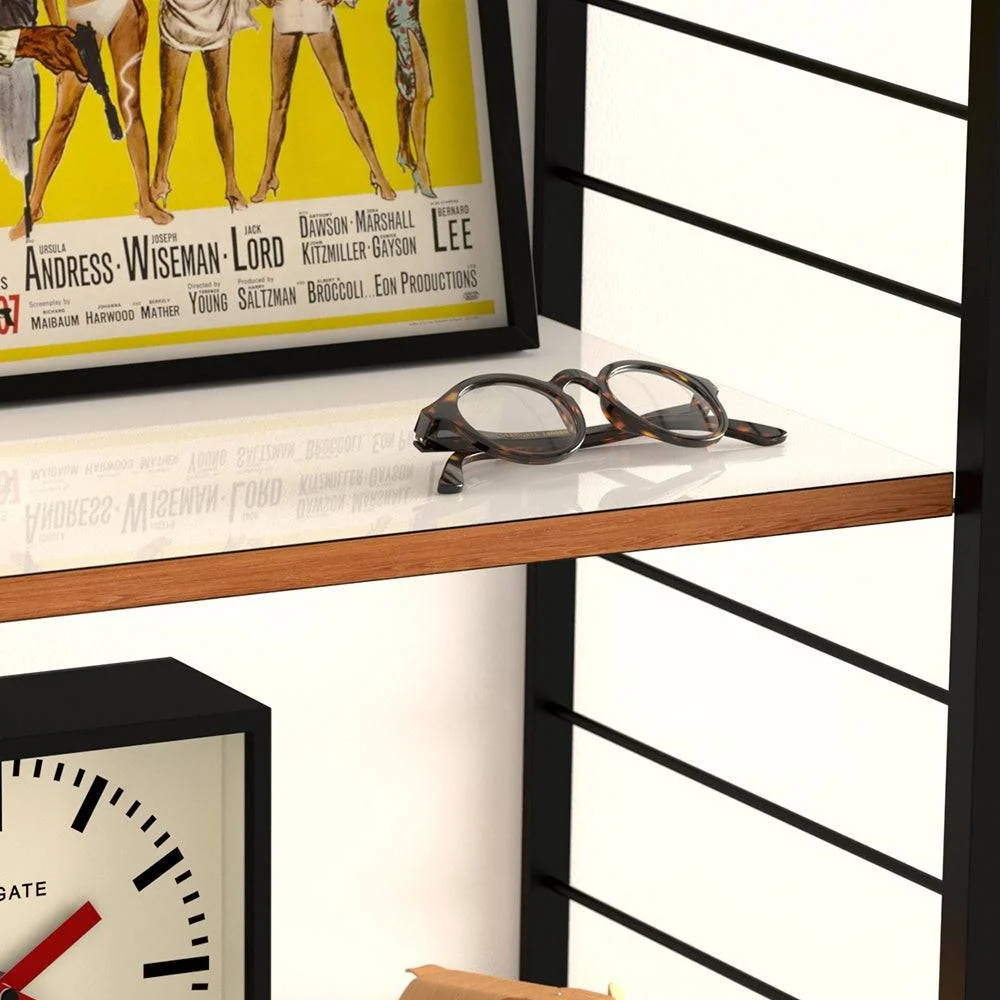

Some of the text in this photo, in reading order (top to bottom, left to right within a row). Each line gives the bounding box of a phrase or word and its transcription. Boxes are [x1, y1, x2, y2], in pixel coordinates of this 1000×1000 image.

[299, 209, 415, 238] DAWSON MARSHALL
[438, 204, 470, 217] BERNARD
[39, 225, 262, 255] URSULA JOSEPH JACK
[431, 207, 473, 253] LEE
[25, 226, 284, 291] ANDRESS WISEMAN LORD
[302, 235, 417, 265] KITZMILLER GAYSON
[400, 269, 478, 295] PRODUCTIONS
[188, 291, 228, 315] YOUNG
[238, 286, 297, 310] SALTZMAN
[31, 305, 180, 330] MAIBAUM HARWOOD MATHER
